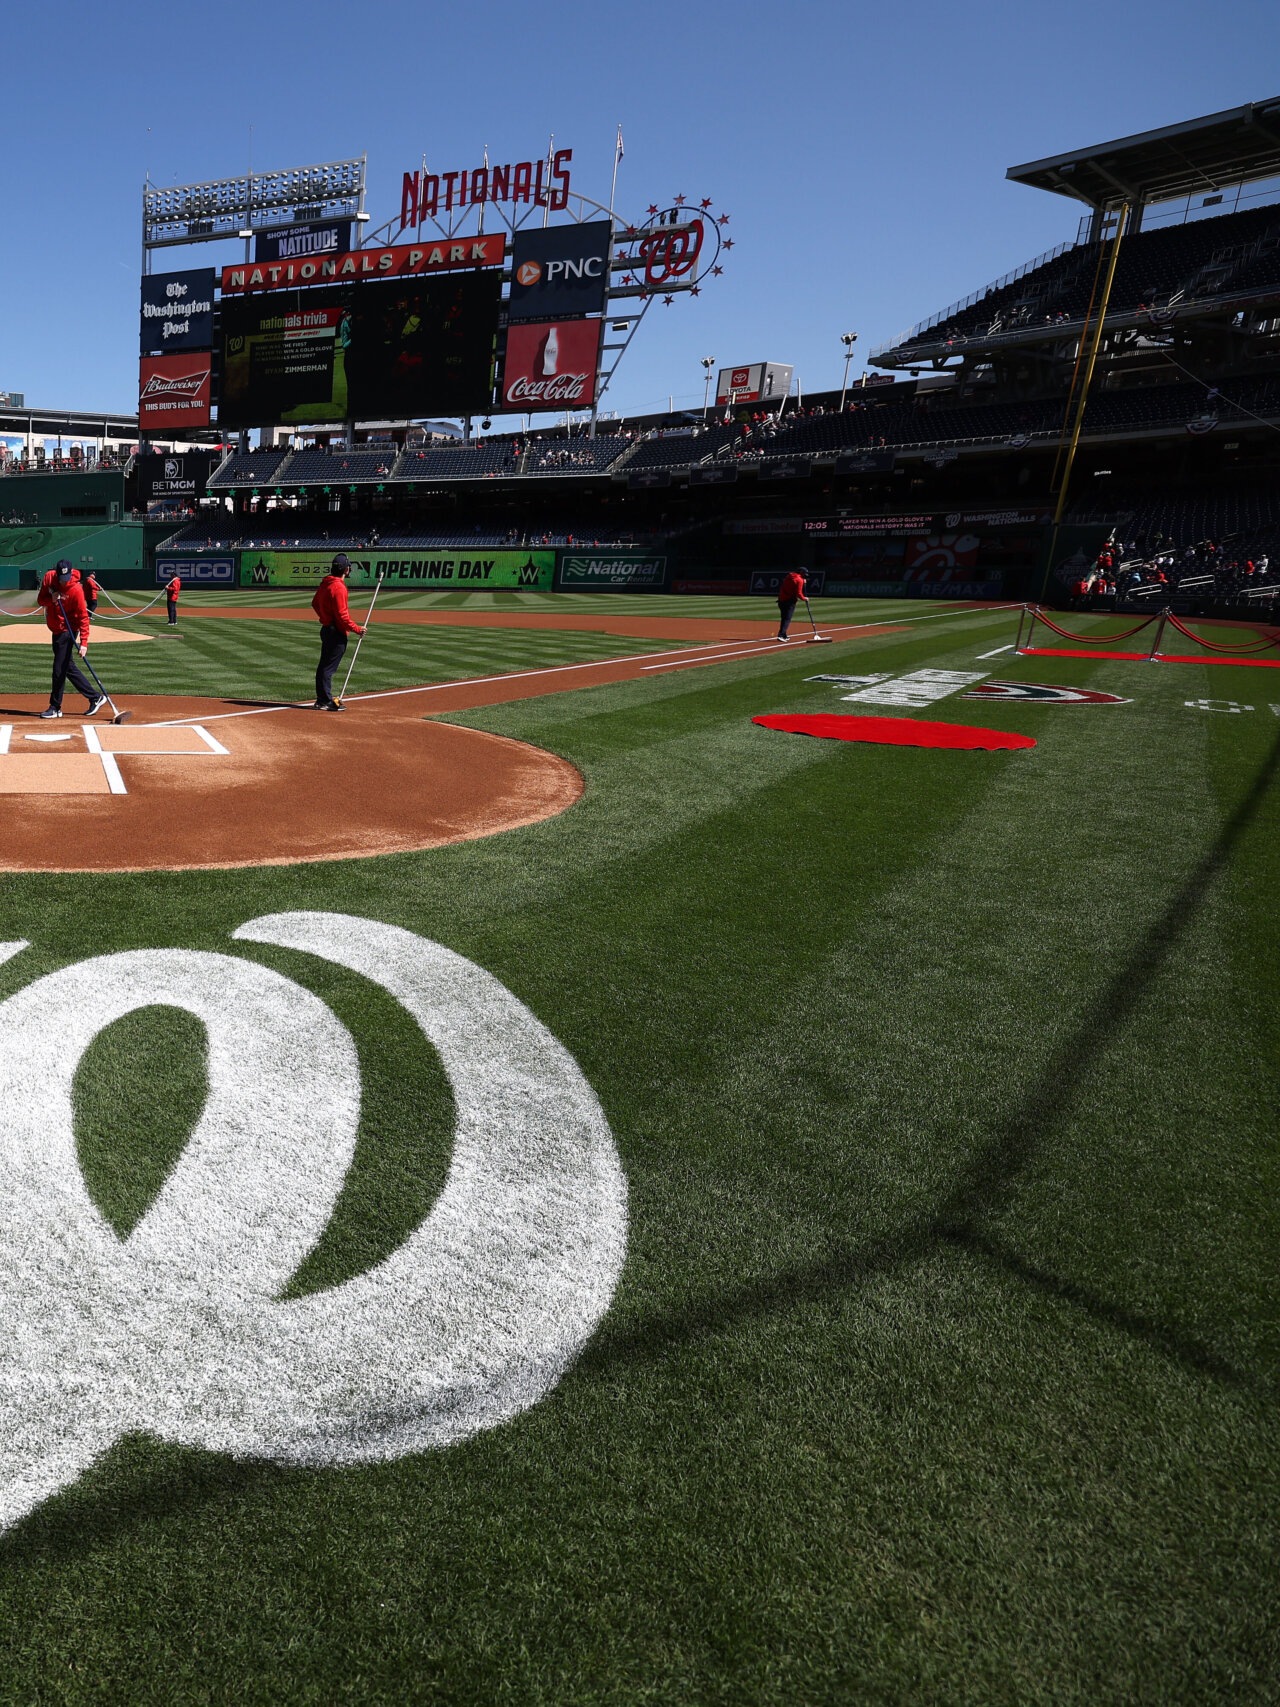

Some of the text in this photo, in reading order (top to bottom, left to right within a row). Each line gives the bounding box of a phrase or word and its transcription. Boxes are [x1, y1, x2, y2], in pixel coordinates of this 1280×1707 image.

[400, 149, 573, 229] NATIONALS
[266, 226, 310, 240] SHOW SOME
[278, 229, 338, 257] NATITUDE
[231, 242, 488, 287] NATIONALS PARK
[545, 256, 602, 282] PNC
[166, 282, 188, 298] The
[143, 300, 210, 318] Washington
[260, 312, 328, 330] nationals trivia
[162, 320, 189, 339] Post
[284, 364, 328, 374] ZIMMERMAN
[146, 379, 200, 392] Budweiser
[506, 372, 590, 403] Coca-Cola
[159, 402, 177, 410] BUD'S
[152, 480, 195, 490] BETMGM
[963, 512, 1018, 522] WASHINGTON
[988, 514, 1036, 526] NATIONALS
[804, 522, 828, 530] 12:05
[159, 563, 230, 578] GEICO
[375, 561, 495, 579] OPENING DAY
[587, 560, 660, 575] National
[828, 584, 892, 593] amentum
[921, 584, 996, 596] RE/MAX
